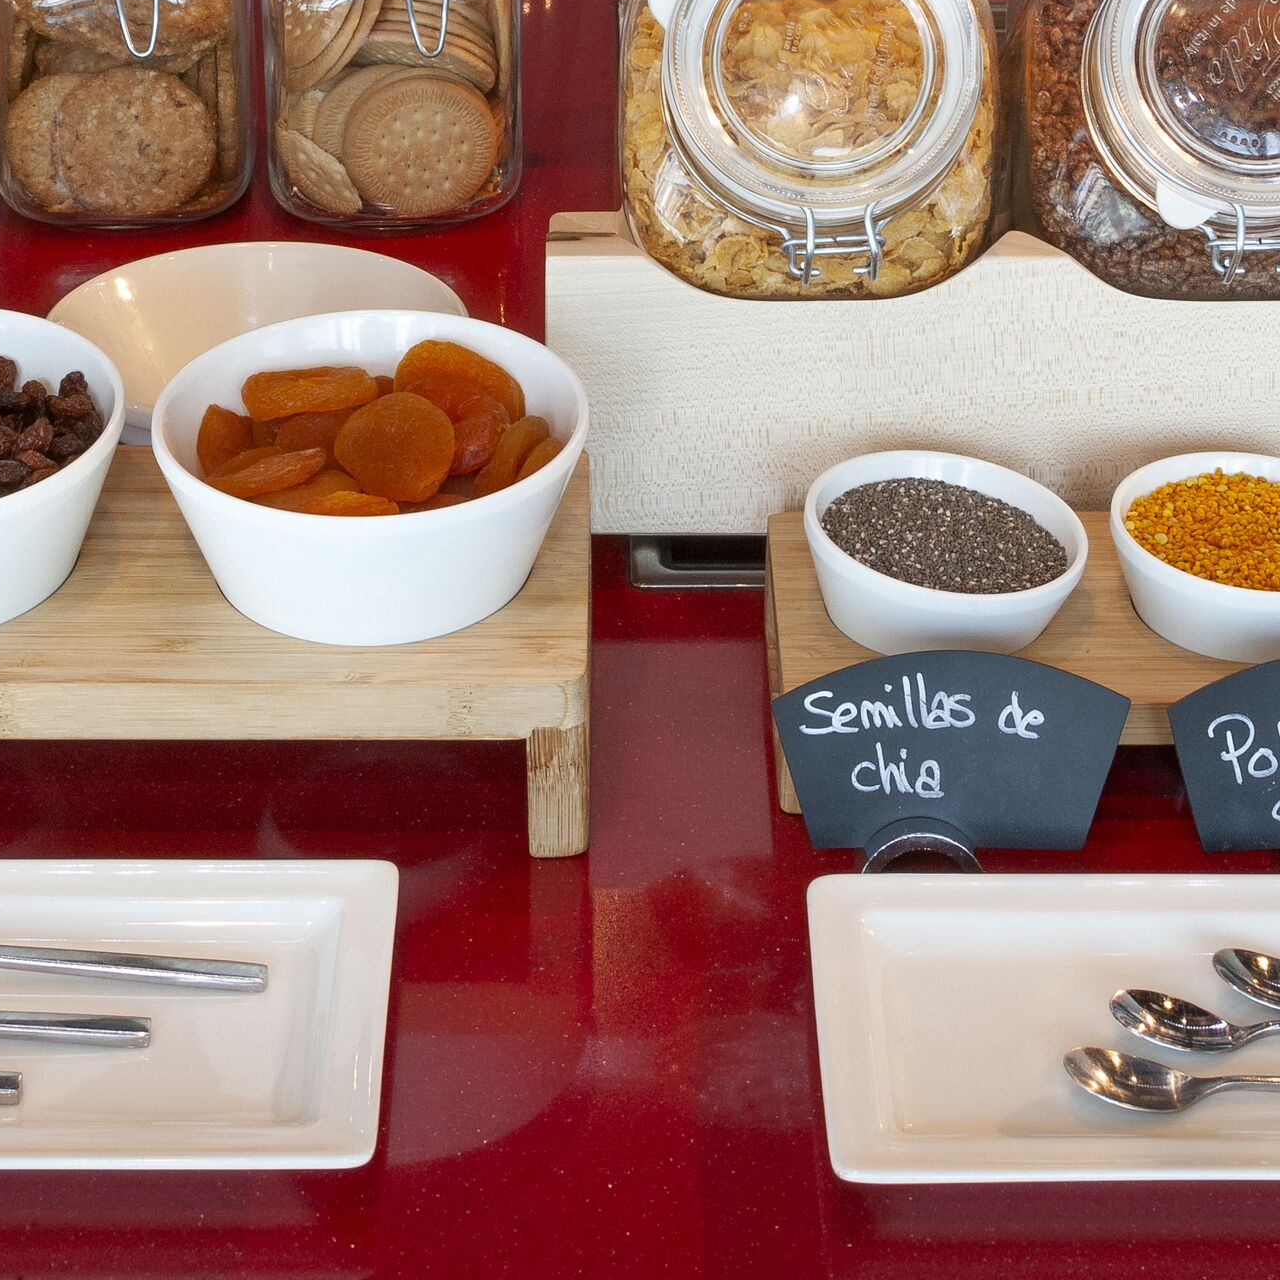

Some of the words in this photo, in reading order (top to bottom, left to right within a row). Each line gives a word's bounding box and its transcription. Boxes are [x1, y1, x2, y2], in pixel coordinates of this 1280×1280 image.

[799, 672, 976, 735] Semillas
[997, 690, 1046, 739] de
[850, 741, 945, 799] chia
